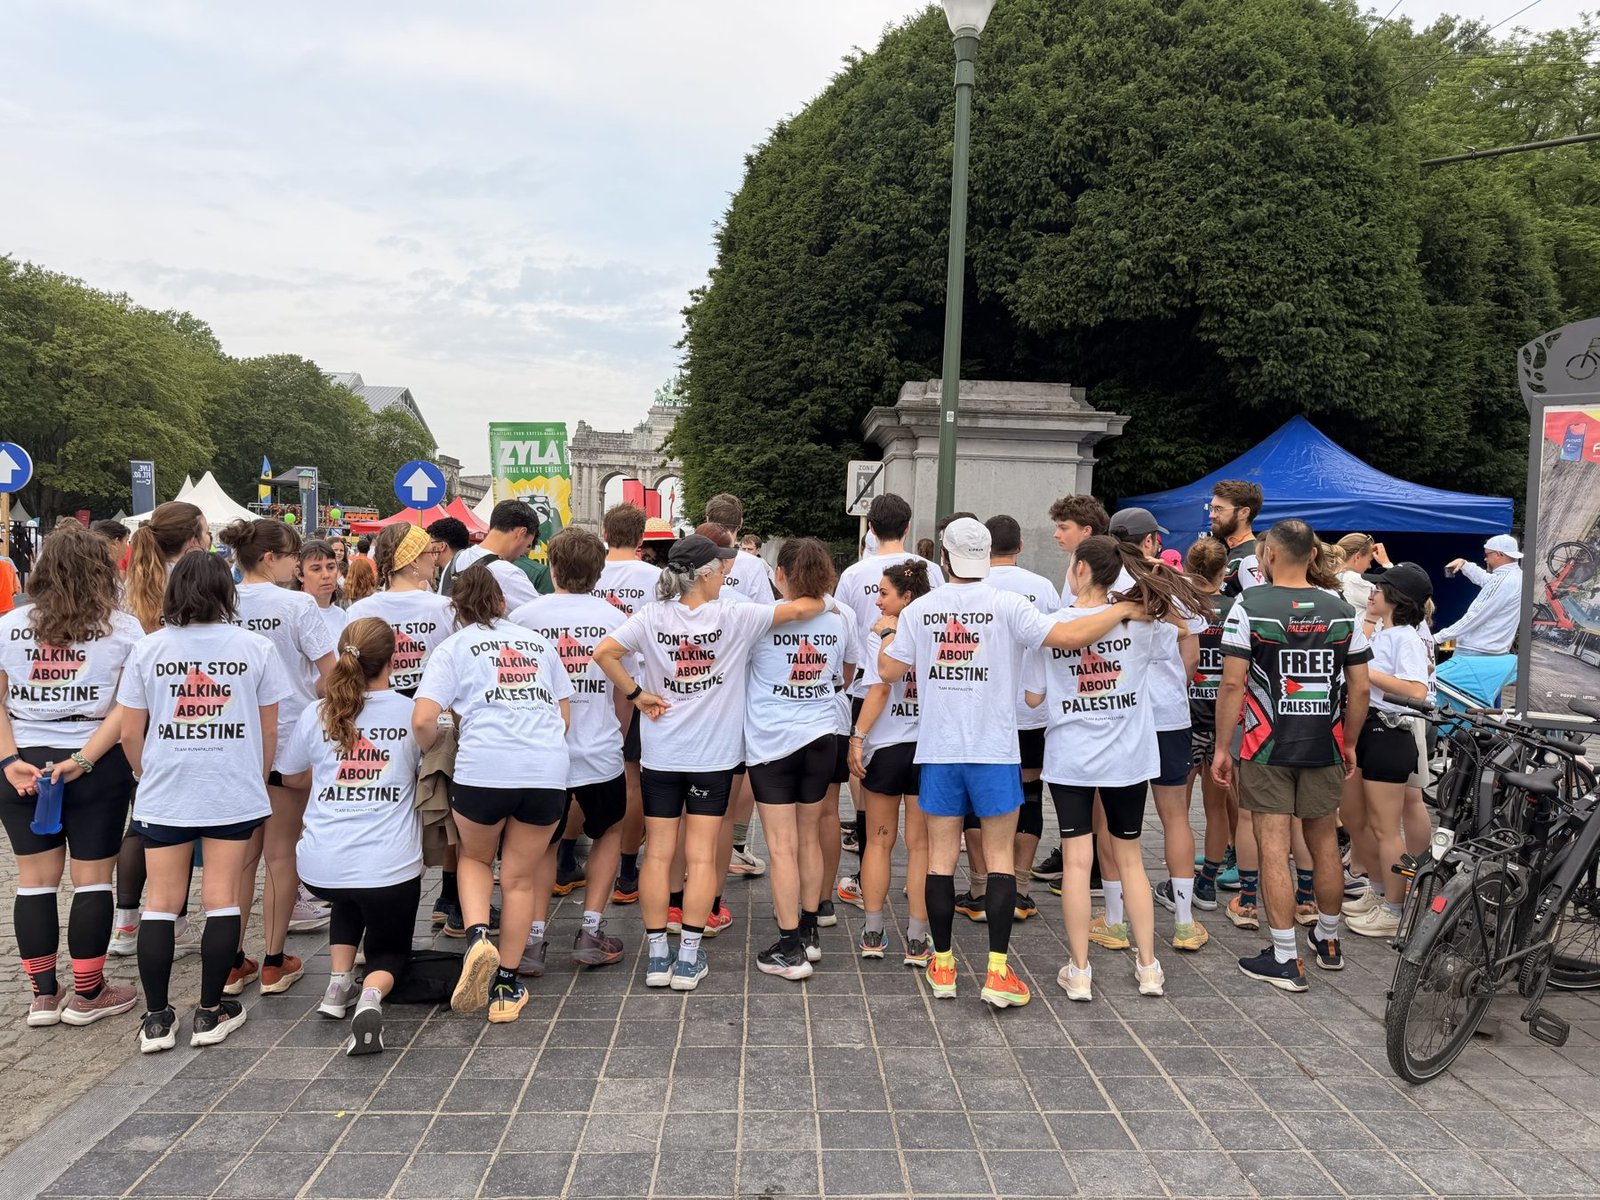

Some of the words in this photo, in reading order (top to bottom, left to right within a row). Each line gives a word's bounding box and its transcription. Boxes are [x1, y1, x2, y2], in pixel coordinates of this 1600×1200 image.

[500, 440, 562, 465] ZYLA
[618, 588, 646, 598] STOP
[248, 618, 280, 630] STOP
[924, 612, 958, 626] DON'T
[962, 612, 993, 625] STOP
[406, 622, 436, 634] STOP
[574, 627, 607, 638] STOP
[1287, 625, 1328, 634] PALESTINE
[658, 632, 690, 646] DON'T
[694, 629, 722, 644] STOP
[774, 634, 810, 646] DON'T
[814, 634, 838, 646] STOP
[932, 632, 980, 644] TALKING
[395, 641, 426, 653] KING
[470, 640, 509, 656] DON'T
[514, 641, 545, 654] STOP
[1052, 644, 1092, 660] DONT
[1097, 638, 1132, 654] STOP
[25, 648, 86, 662] TALKING
[668, 650, 716, 662] TALKING
[786, 653, 828, 664] TALKING
[939, 650, 974, 661] ABOUT
[393, 658, 422, 670] BOUT
[489, 656, 538, 668] TALKING
[1069, 660, 1122, 676] TALKING
[1280, 650, 1334, 674] FREE
[32, 668, 78, 680] ABOUT
[156, 662, 202, 676] DON'T
[207, 662, 248, 676] STOP
[566, 663, 588, 674] OUT
[677, 666, 712, 678] ABOUT
[928, 666, 989, 682] ALESTINE
[500, 672, 536, 684] ABOUT
[791, 670, 822, 680] ABOUT
[170, 684, 232, 697] TALKING
[572, 680, 606, 694] STINE
[1079, 679, 1118, 692] ABOUT
[11, 686, 100, 702] PALESTINE
[1190, 688, 1217, 698] PALEST
[1062, 692, 1137, 714] PALESTINE
[177, 704, 224, 717] ABOUT
[158, 723, 246, 740] PALESTINE
[369, 728, 408, 741] STOP
[336, 750, 390, 762] TALKING
[339, 768, 382, 780] ABOUT
